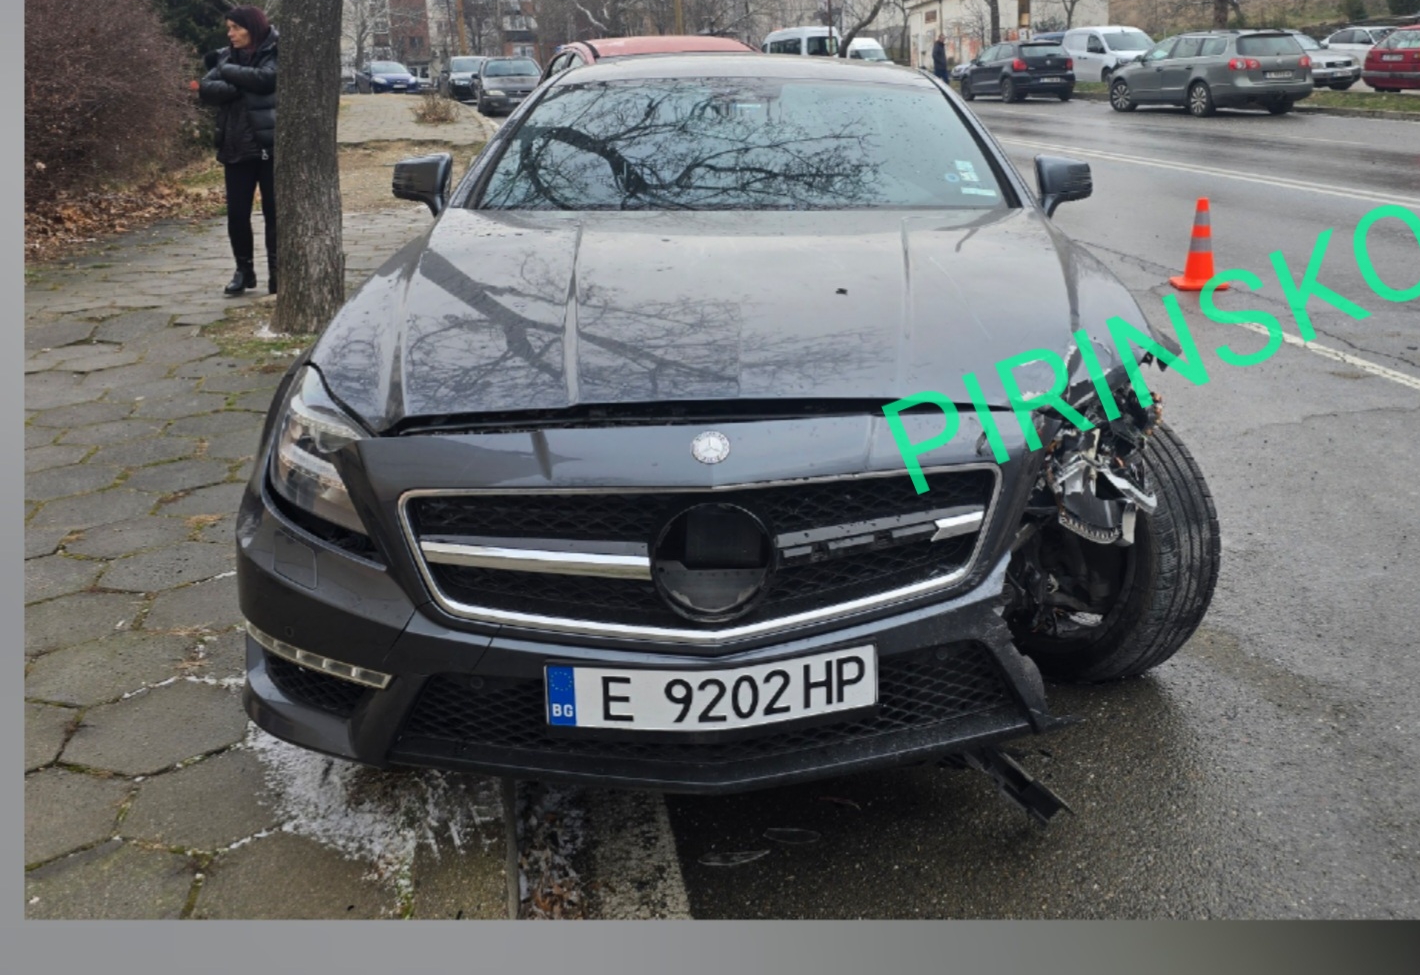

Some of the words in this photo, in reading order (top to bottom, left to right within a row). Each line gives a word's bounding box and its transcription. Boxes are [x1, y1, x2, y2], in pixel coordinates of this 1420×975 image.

[552, 703, 574, 718] BG
[601, 676, 634, 723] E
[664, 669, 791, 723] 9202
